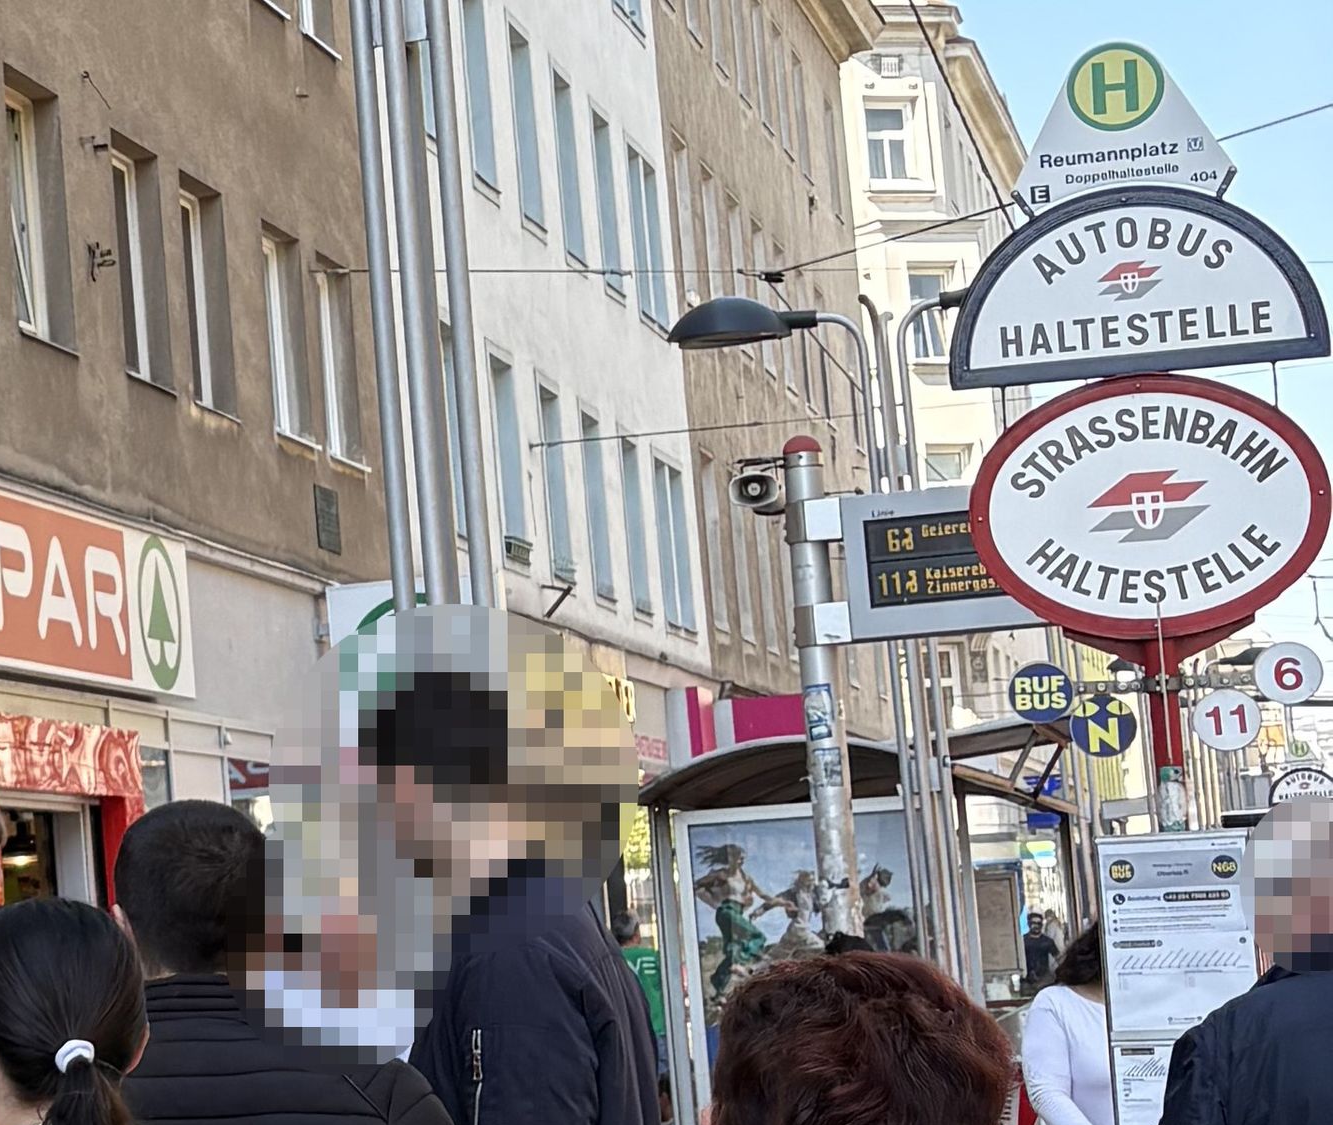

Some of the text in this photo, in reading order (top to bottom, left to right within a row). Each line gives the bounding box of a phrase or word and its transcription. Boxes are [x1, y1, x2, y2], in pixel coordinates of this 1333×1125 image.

[1091, 59, 1139, 116] H
[1040, 142, 1179, 170] Reumannplatz
[1065, 164, 1180, 185] Doppelhaltestelle
[1190, 171, 1218, 183] 404
[1033, 216, 1234, 286] AUTOBUS
[1000, 301, 1274, 359] HALTESTELLE
[1010, 404, 1290, 499] STRASSENBAHN
[887, 522, 972, 553] 6 Geiere
[1027, 523, 1282, 605] HALTESTELLE
[878, 571, 902, 597] 11
[927, 577, 1000, 595] Zinnergas
[1014, 677, 1066, 694] RUF
[1274, 657, 1304, 691] 6
[1014, 692, 1068, 711] BUS
[1087, 719, 1120, 752] N
[1205, 704, 1248, 737] 11
